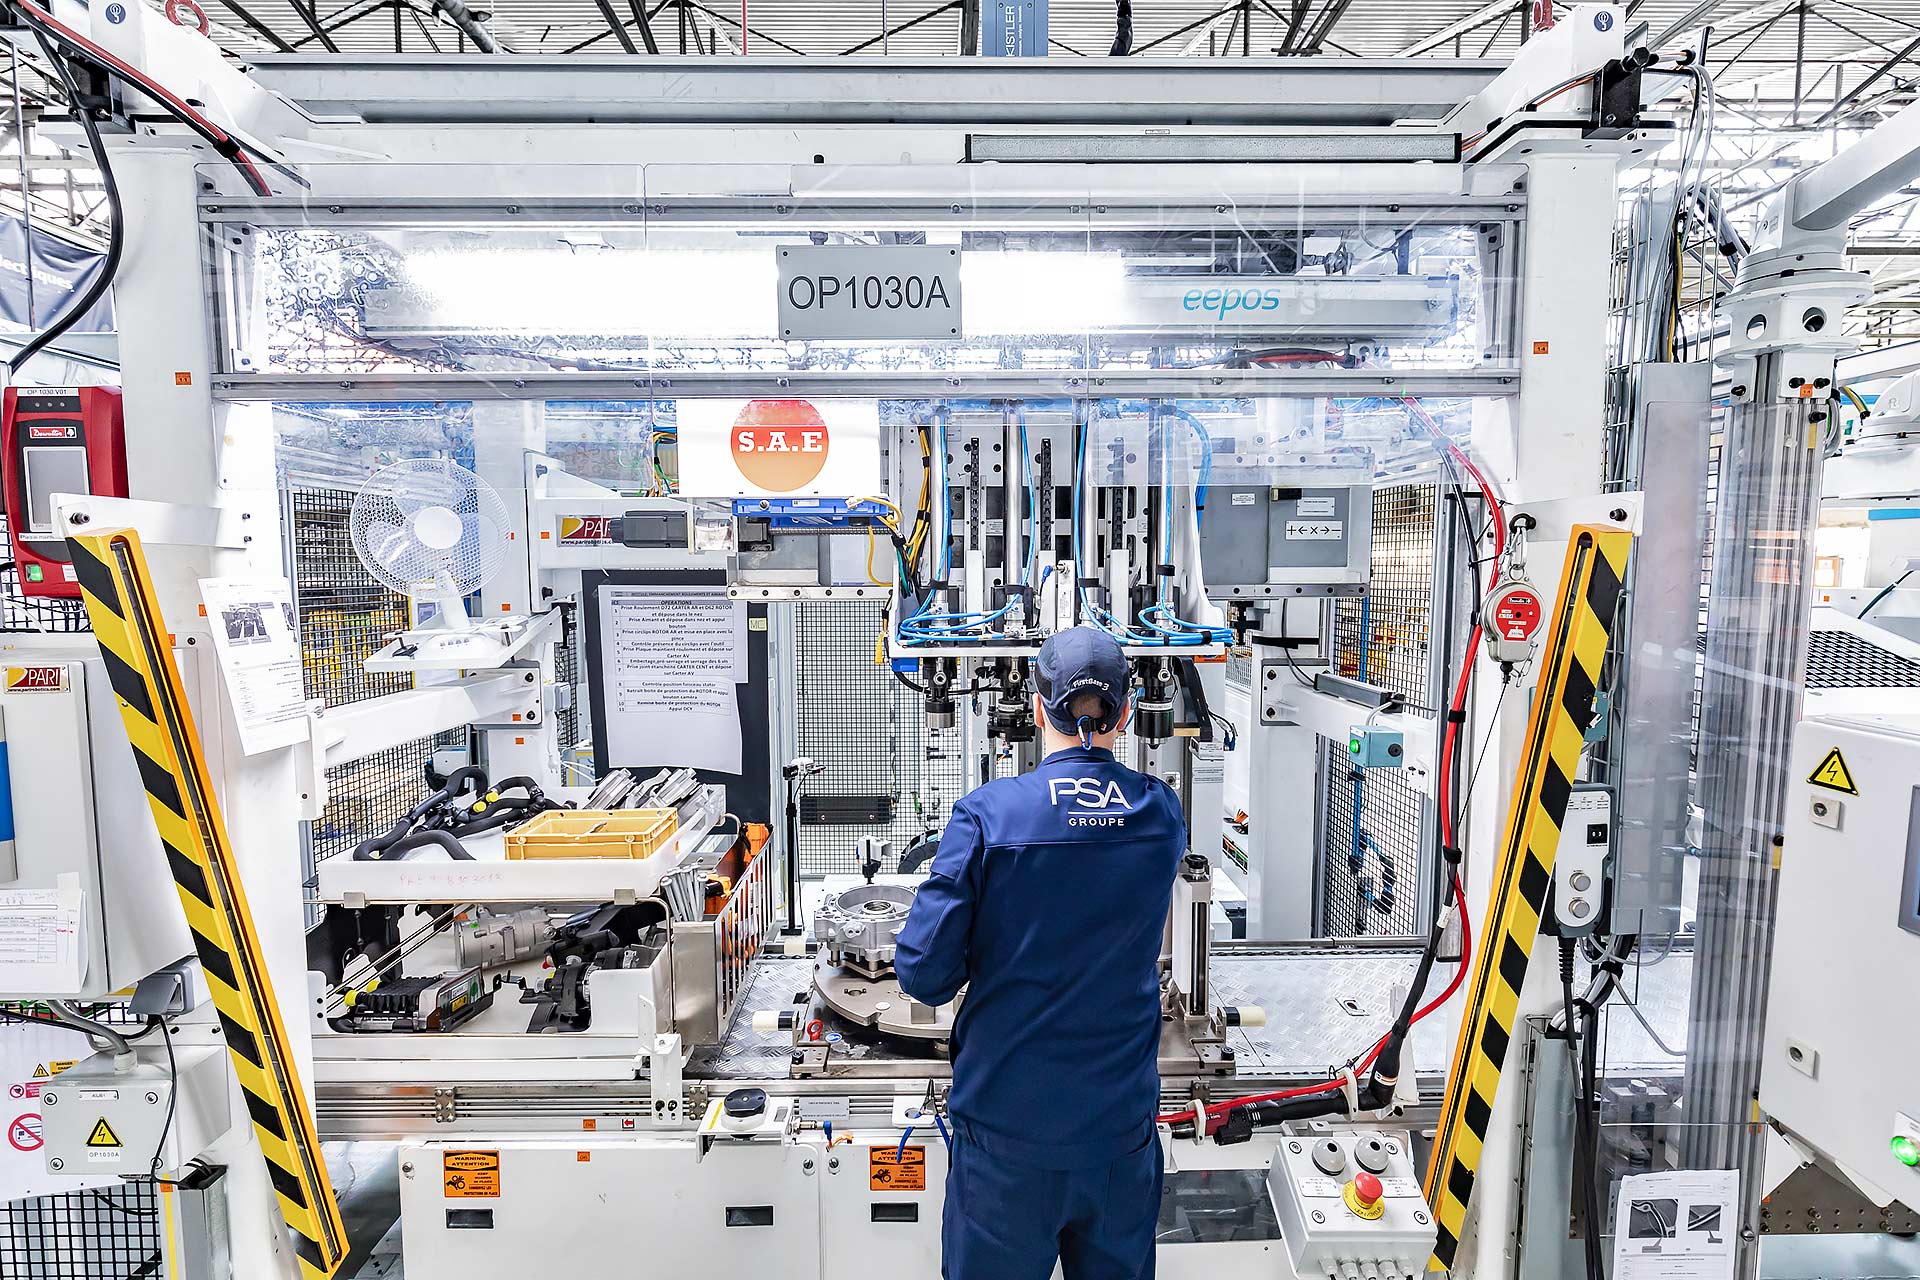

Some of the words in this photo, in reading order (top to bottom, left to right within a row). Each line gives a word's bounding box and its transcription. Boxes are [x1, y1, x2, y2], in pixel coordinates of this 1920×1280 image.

[1005, 6, 1016, 56] KISTLER
[788, 276, 950, 310] OP1030A
[1183, 288, 1280, 320] eepos
[738, 431, 822, 452] S.A.E
[28, 668, 60, 686] PARI
[1072, 678, 1102, 688] FirstBase
[1048, 778, 1133, 810] PSA
[1068, 818, 1125, 826] GROUPE
